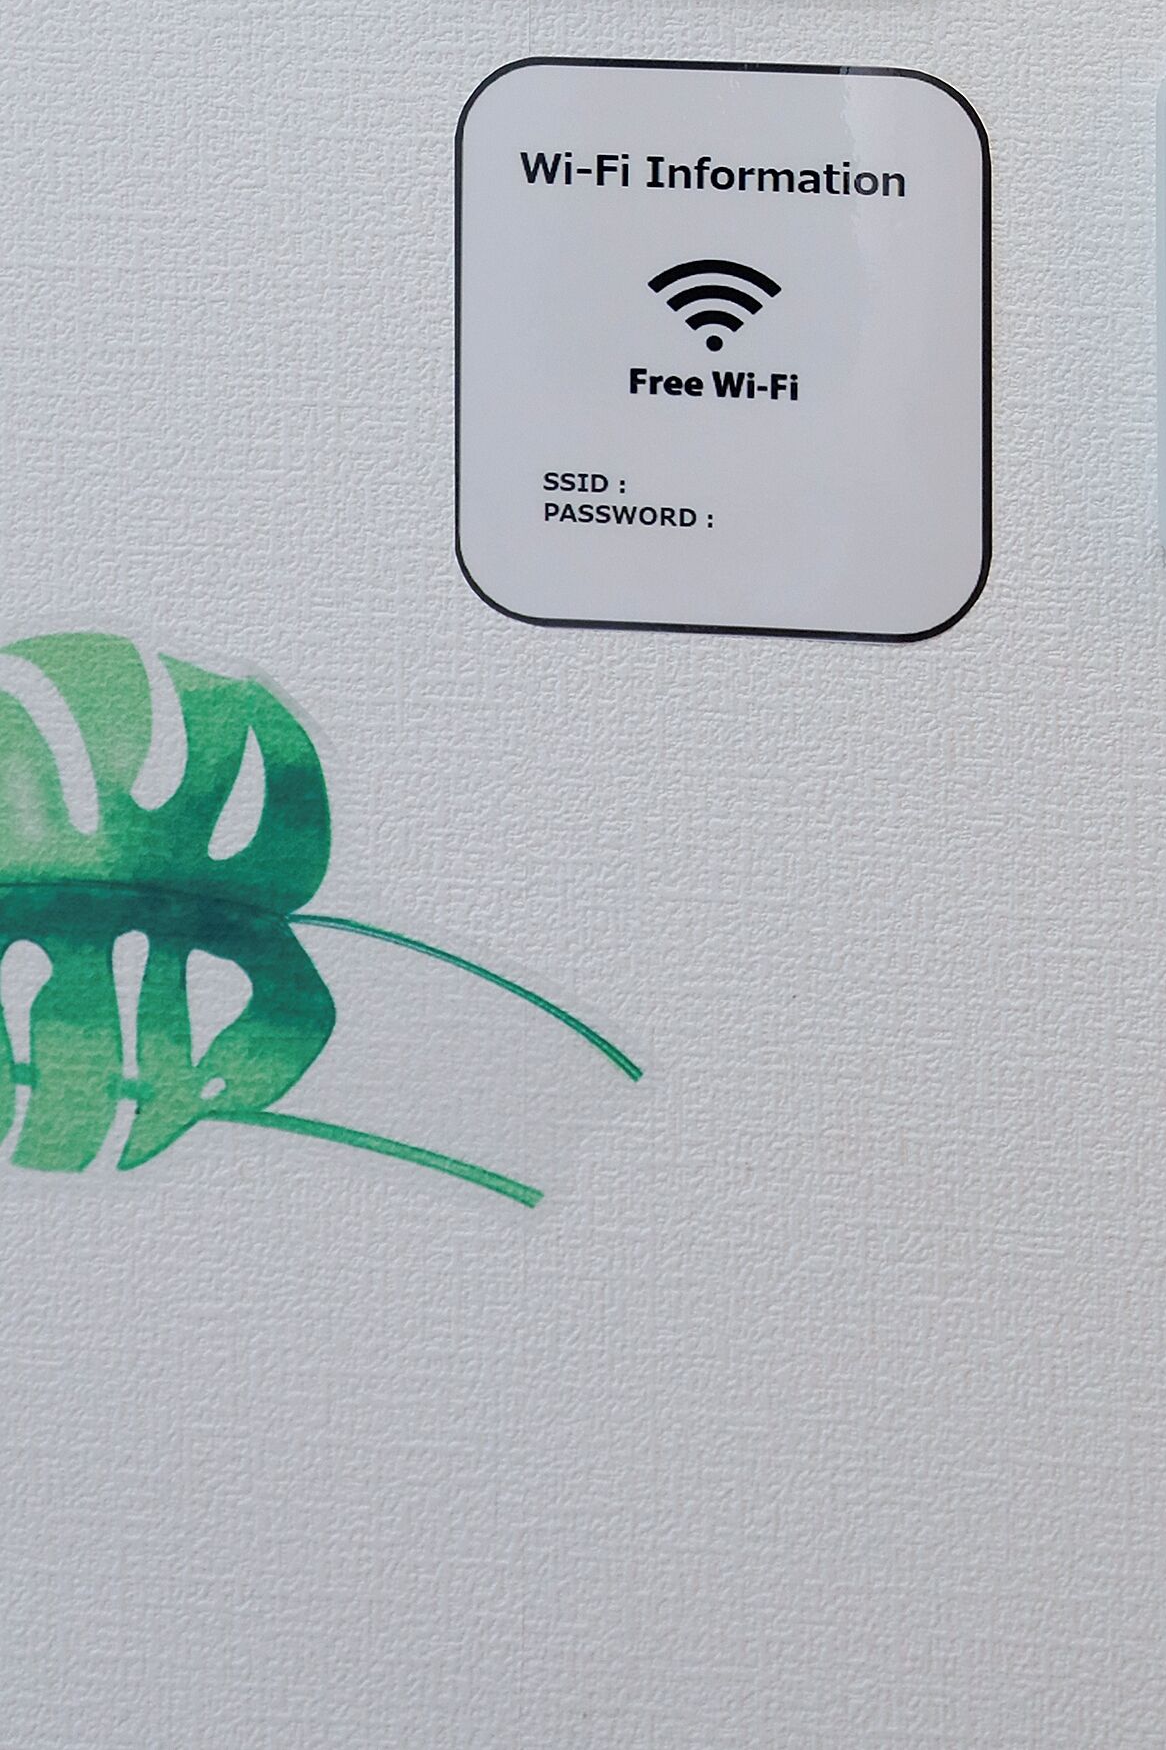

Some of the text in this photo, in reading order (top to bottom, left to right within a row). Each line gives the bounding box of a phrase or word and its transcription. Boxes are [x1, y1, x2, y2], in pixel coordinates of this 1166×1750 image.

[520, 151, 906, 197] Wi-Fi Information
[629, 367, 799, 401] Free Wi-Fi
